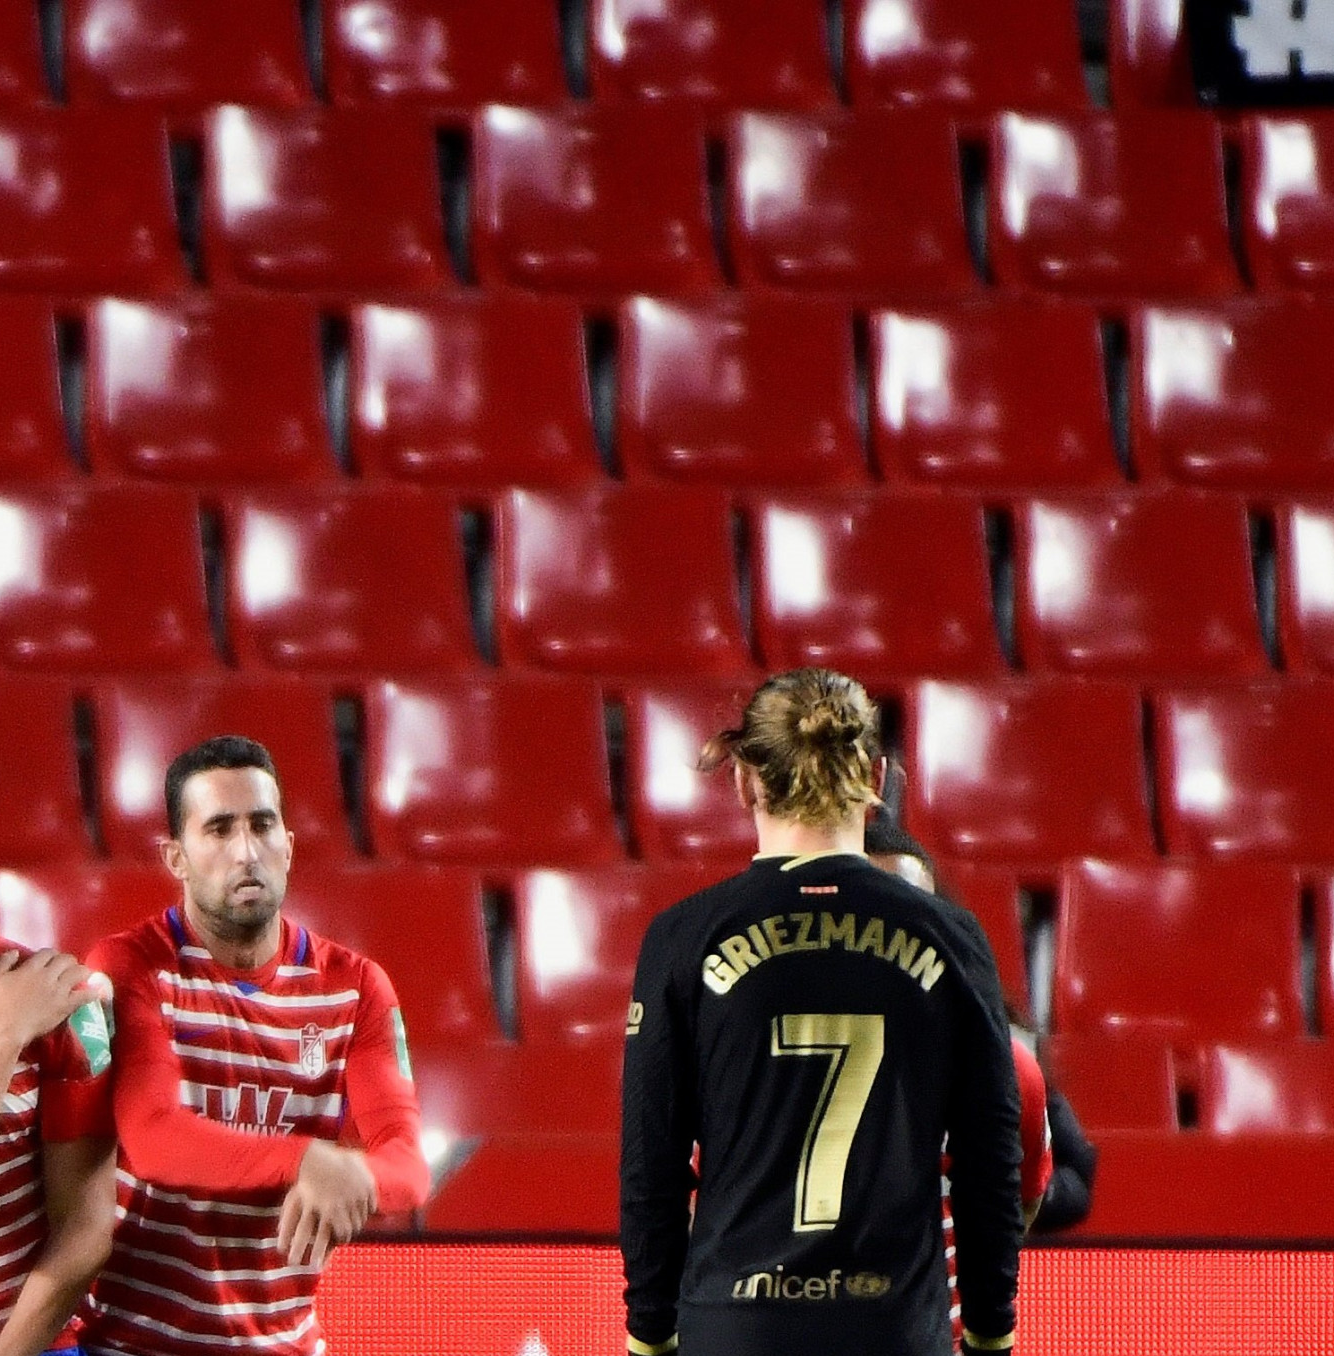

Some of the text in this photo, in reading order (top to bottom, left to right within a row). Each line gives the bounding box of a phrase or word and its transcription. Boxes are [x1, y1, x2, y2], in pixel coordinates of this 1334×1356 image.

[702, 911, 946, 995] GRIEZMANN
[771, 1013, 885, 1233] 7
[731, 1264, 842, 1300] unicef
